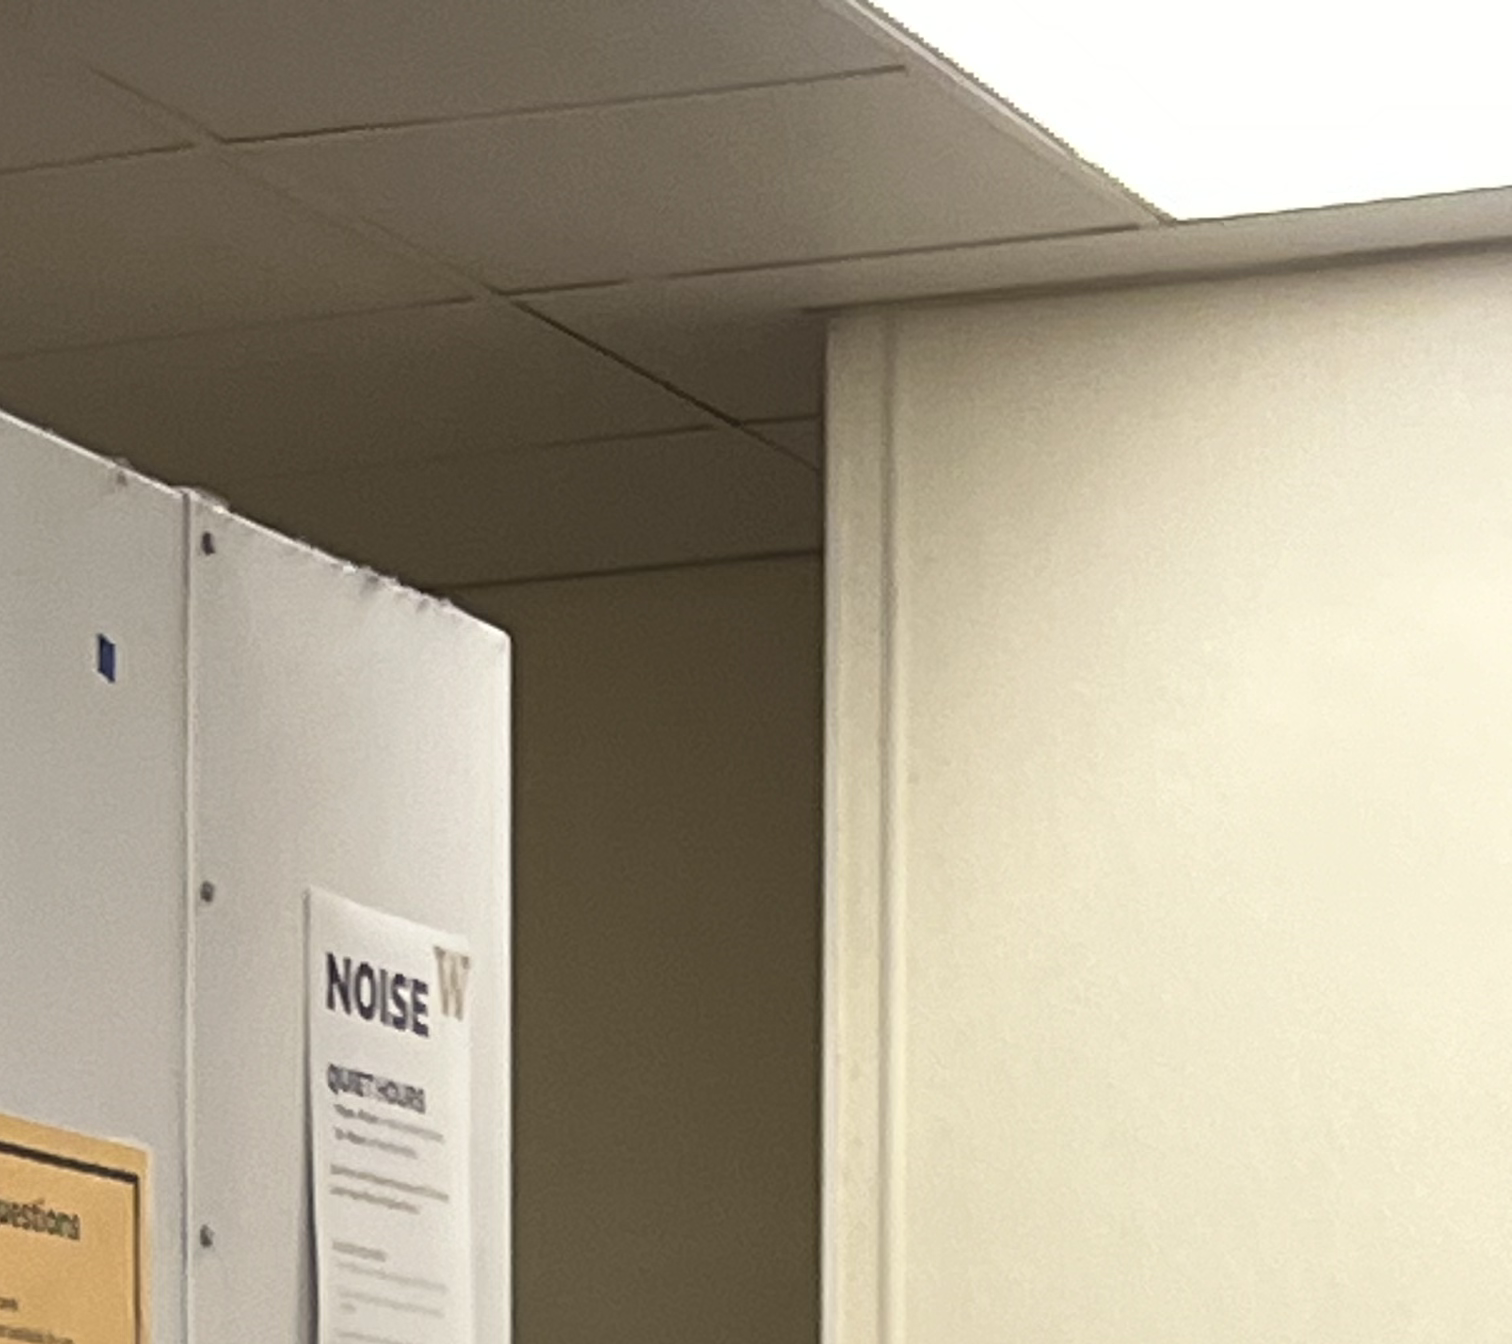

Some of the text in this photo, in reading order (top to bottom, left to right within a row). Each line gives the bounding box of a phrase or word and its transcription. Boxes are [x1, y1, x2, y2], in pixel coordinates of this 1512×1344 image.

[325, 952, 429, 1037] NOISE
[327, 1063, 427, 1115] QUIET HOURS
